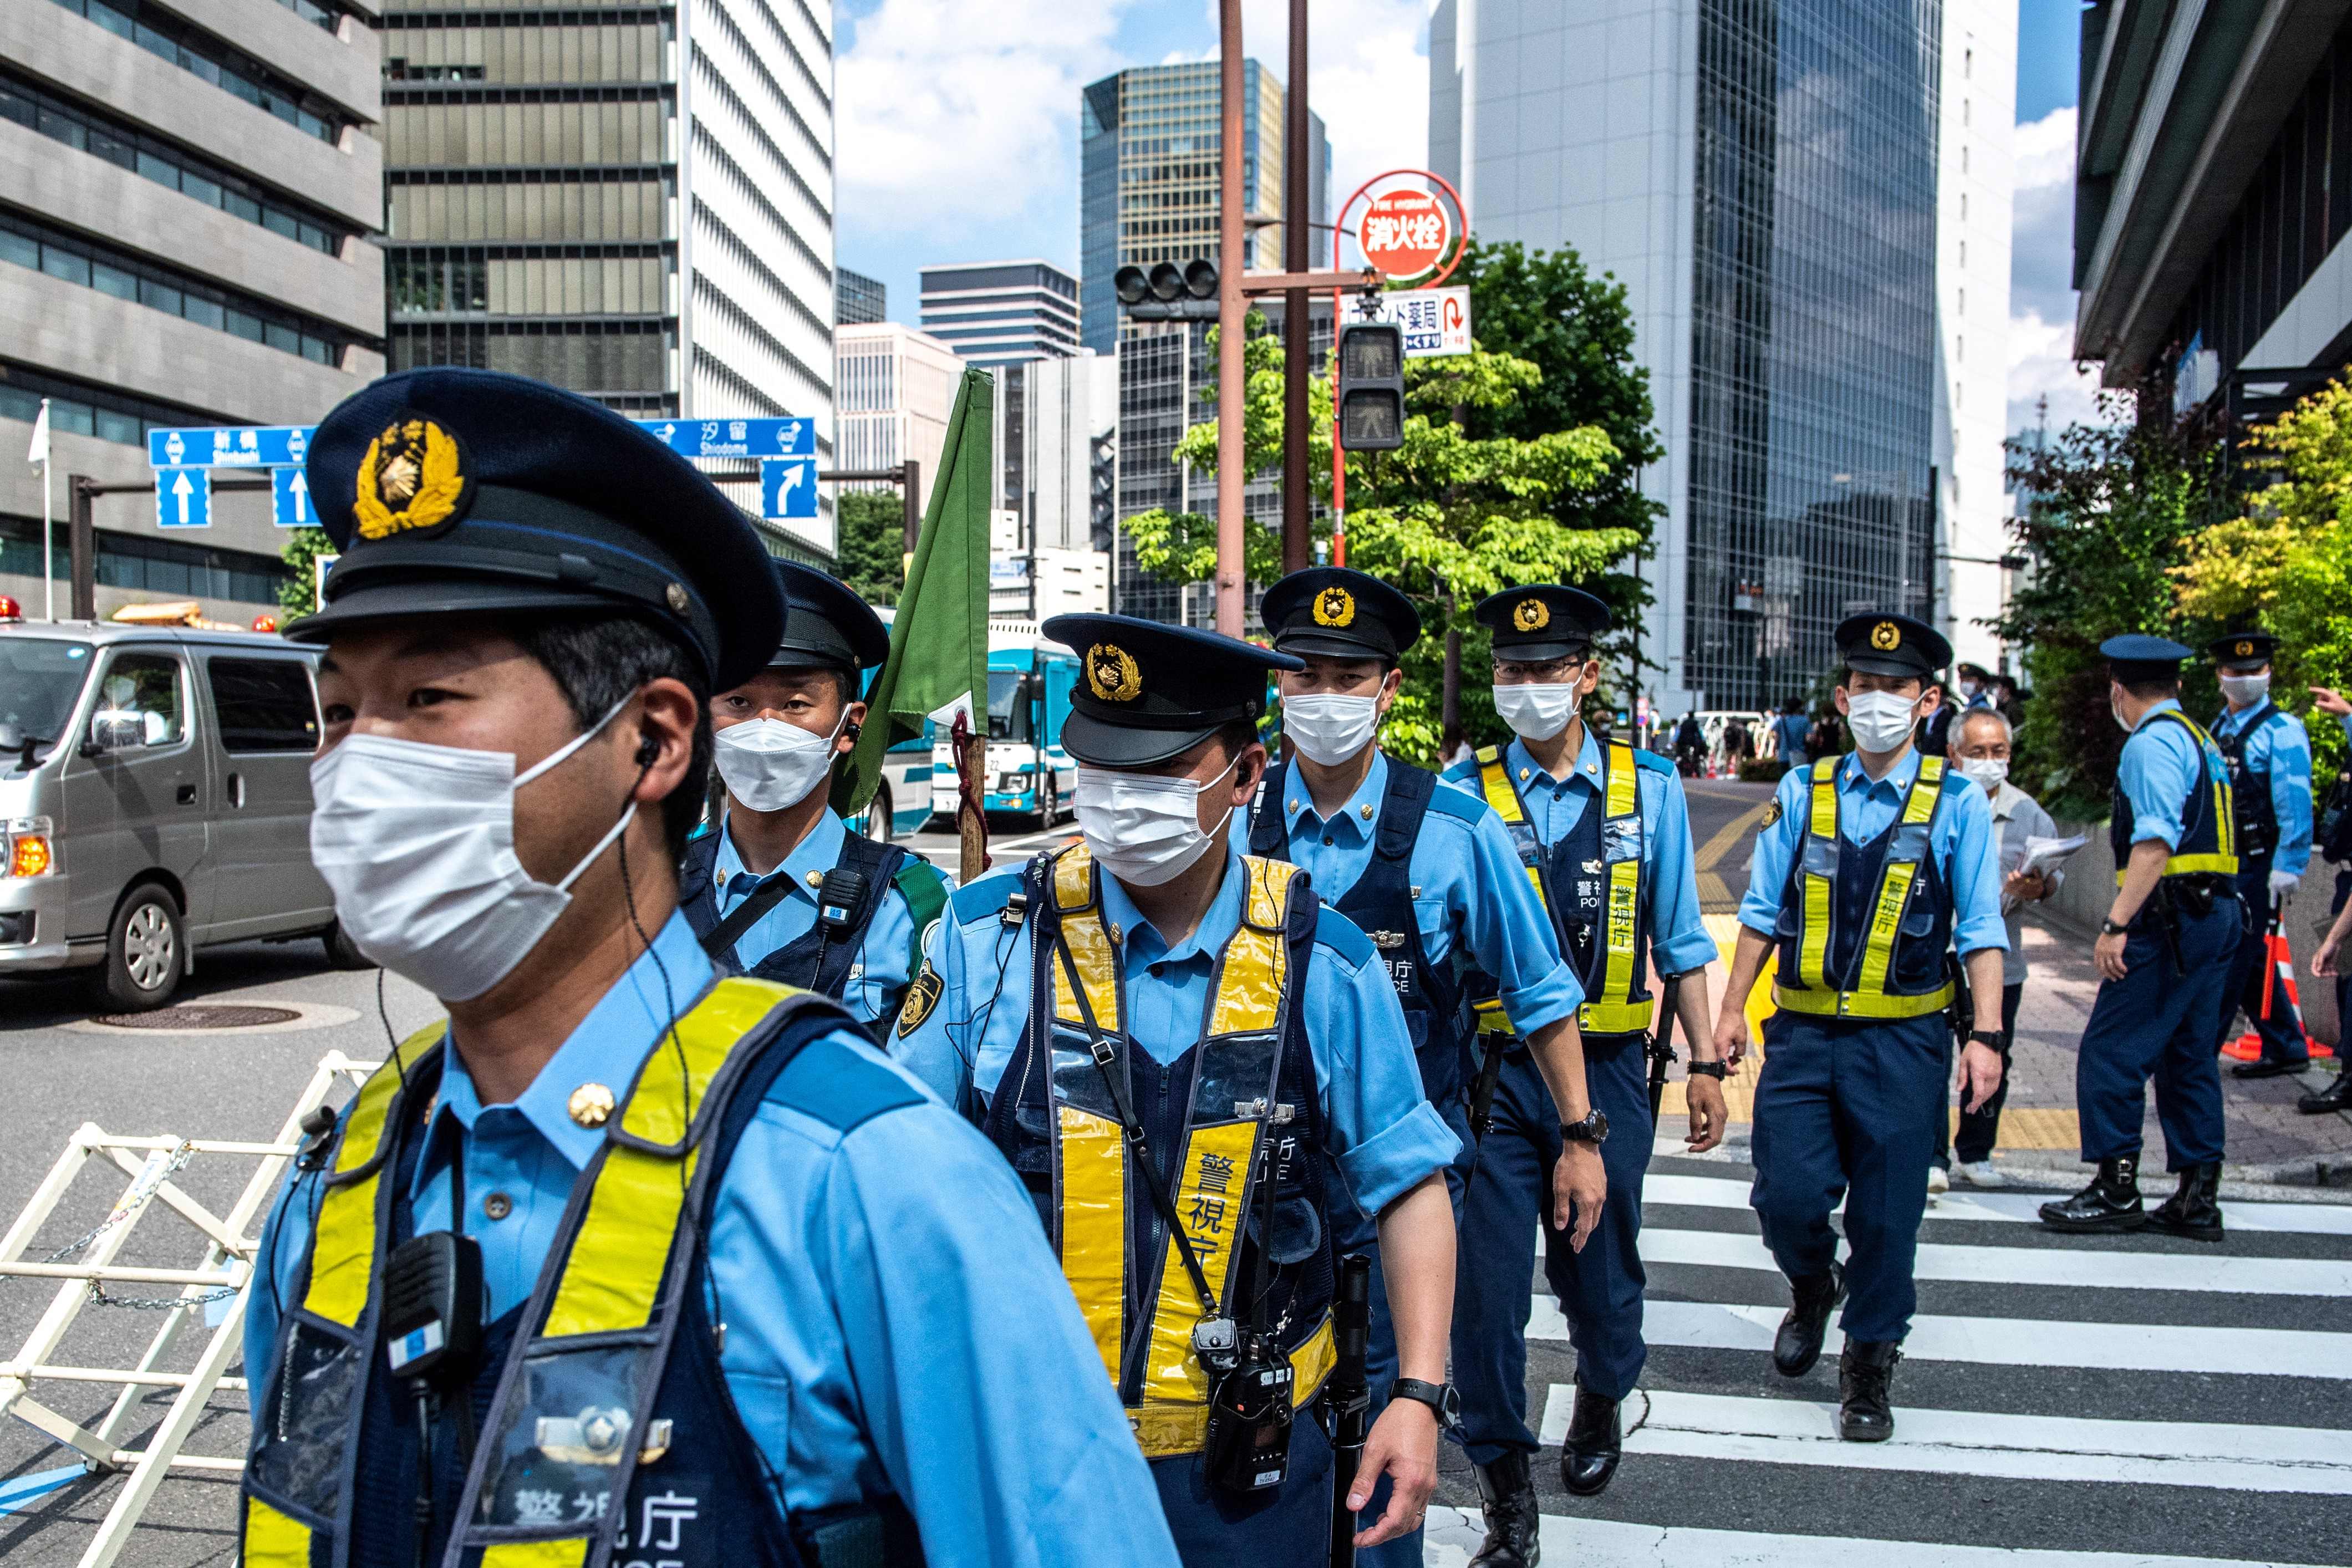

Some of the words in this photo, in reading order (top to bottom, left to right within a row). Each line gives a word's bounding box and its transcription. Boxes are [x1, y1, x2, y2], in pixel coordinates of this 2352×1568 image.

[1367, 213, 1442, 252] 消火栓
[1612, 885, 1631, 947] 警視庁
[1876, 880, 1903, 934] 警視庁
[1180, 1153, 1235, 1269] 警視庁
